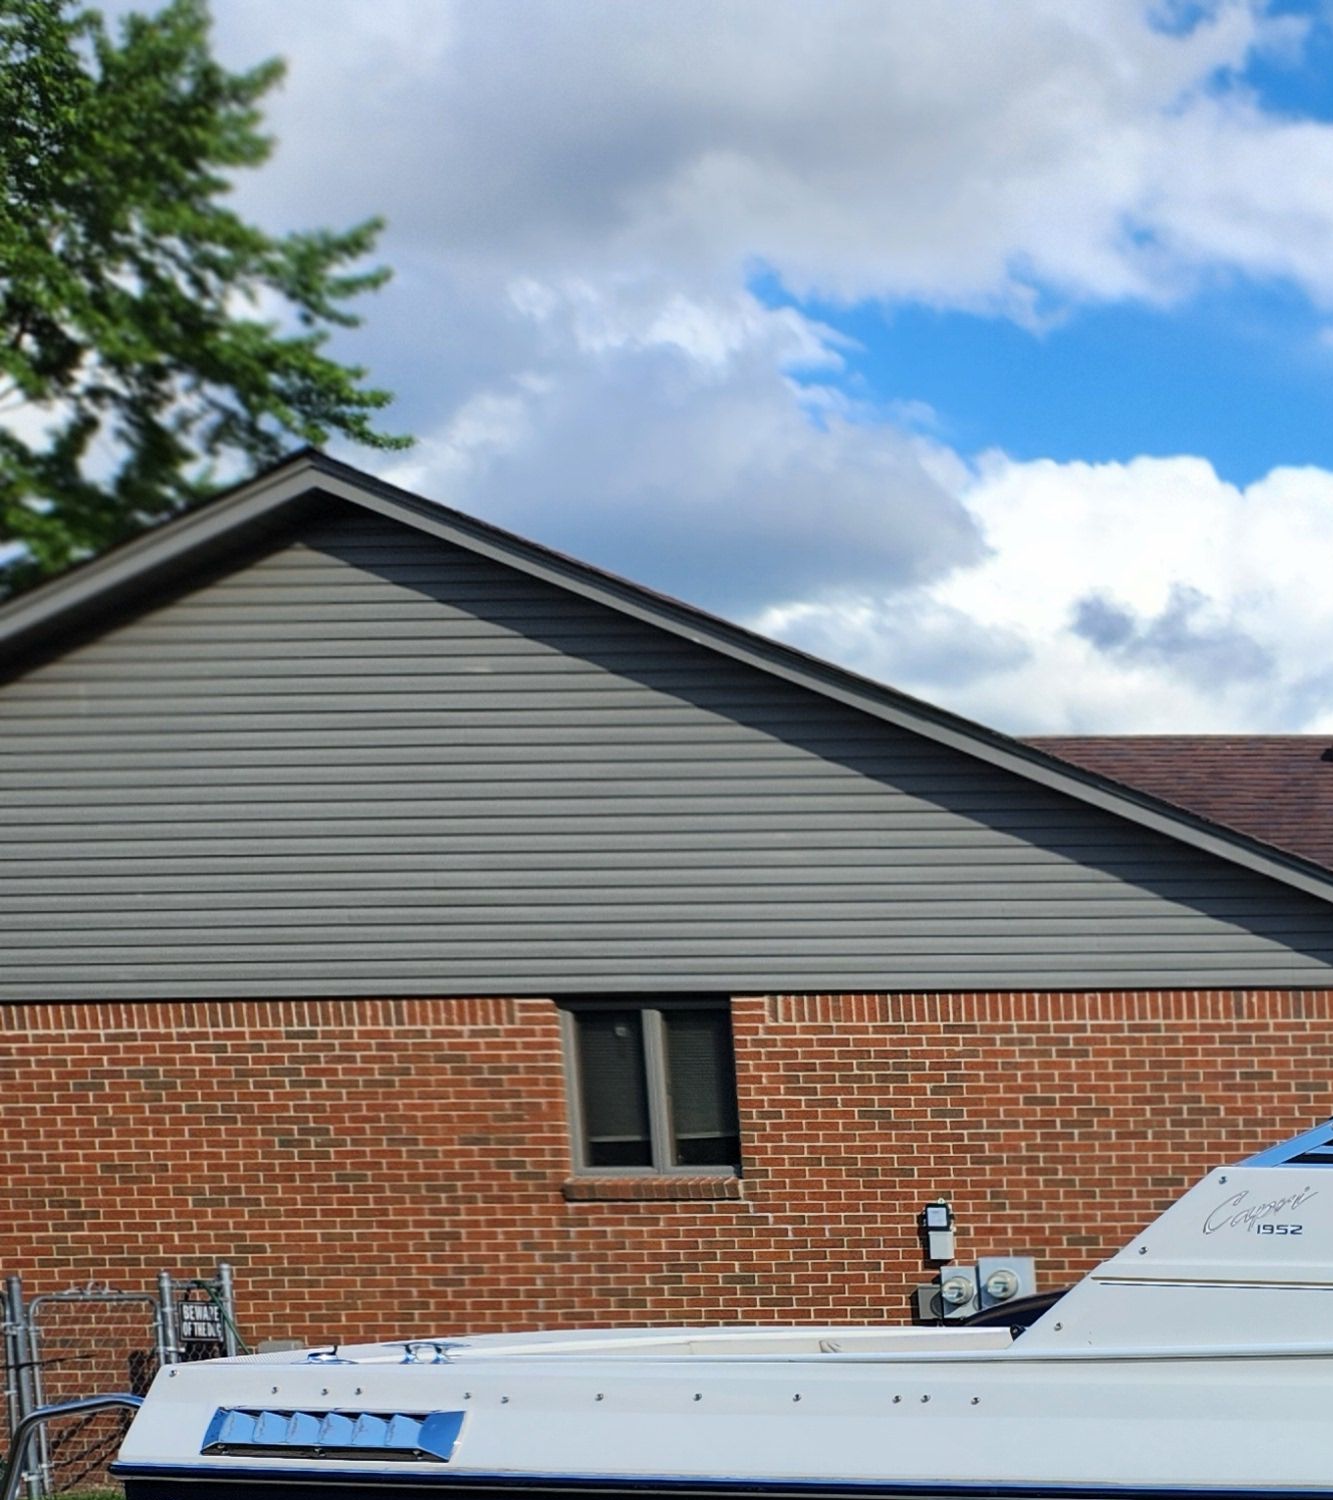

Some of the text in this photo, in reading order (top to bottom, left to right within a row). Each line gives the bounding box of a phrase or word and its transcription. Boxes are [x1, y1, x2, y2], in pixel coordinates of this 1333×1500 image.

[1203, 1186, 1319, 1235] Capri
[1257, 1224, 1303, 1235] 1952
[182, 1321, 192, 1336] OF
[194, 1321, 207, 1336] THE
